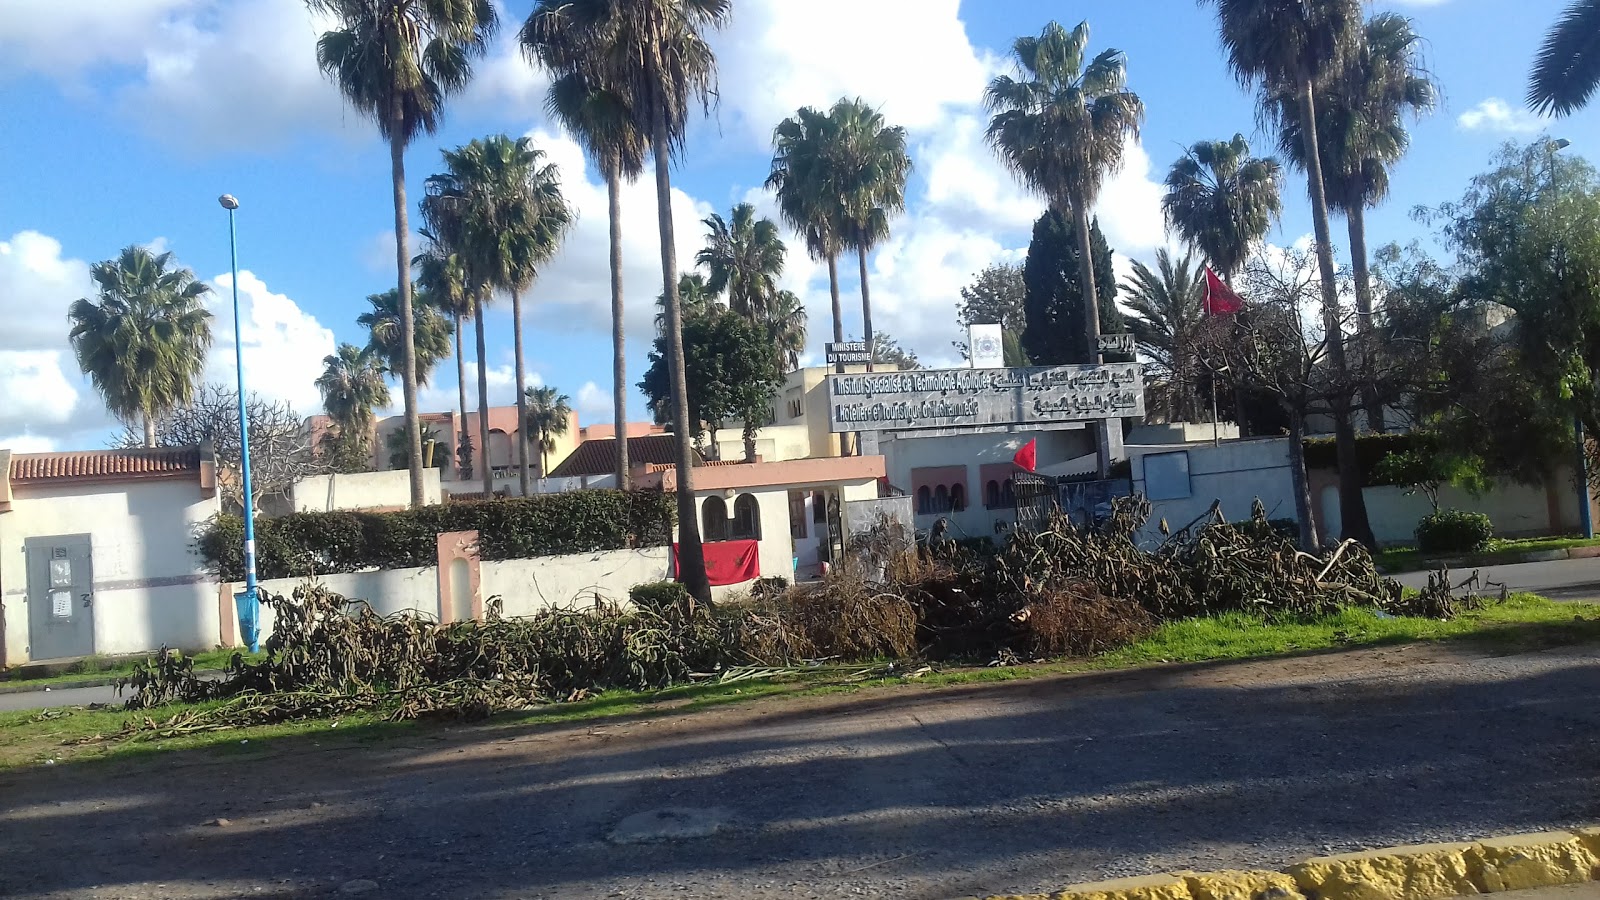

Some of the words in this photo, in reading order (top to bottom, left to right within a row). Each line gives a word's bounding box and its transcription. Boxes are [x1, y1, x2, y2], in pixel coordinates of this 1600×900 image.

[828, 353, 838, 362] DU
[838, 352, 871, 362] TOURISME
[837, 376, 864, 394] Institut
[913, 373, 955, 393] Technologie
